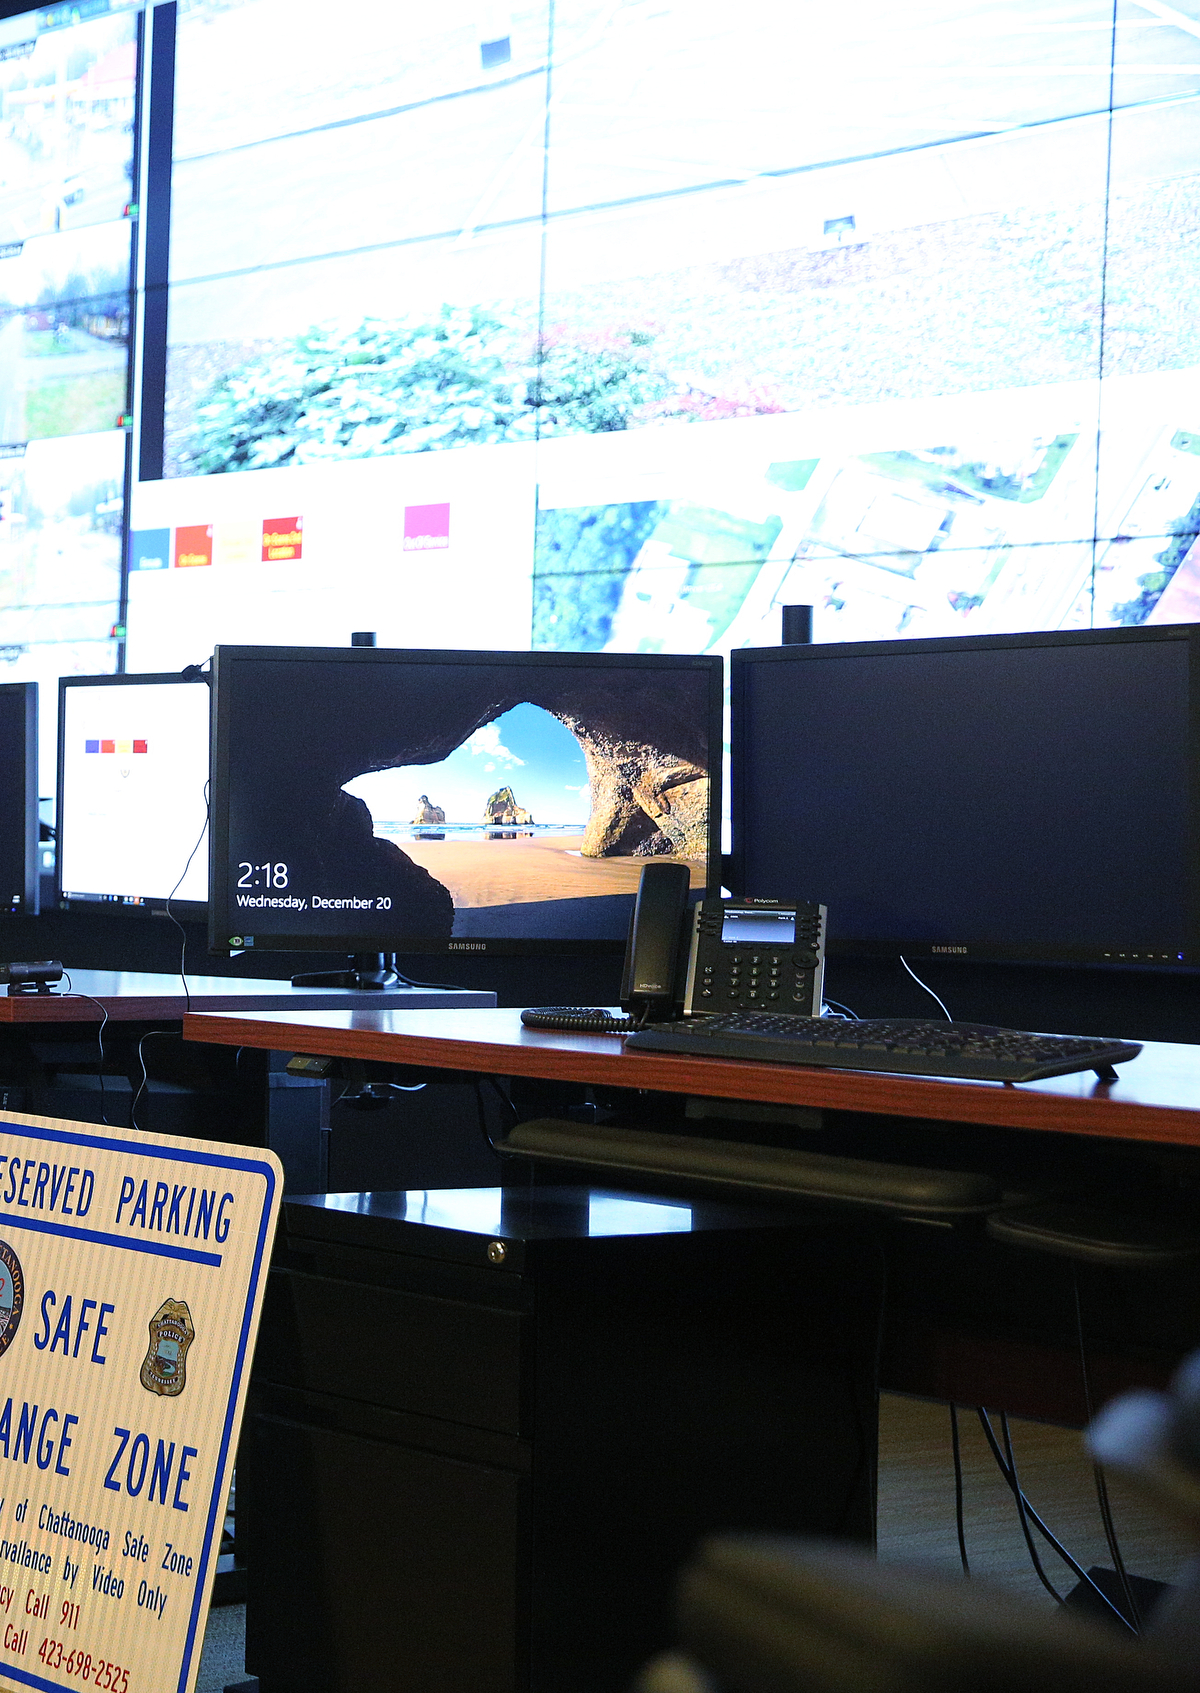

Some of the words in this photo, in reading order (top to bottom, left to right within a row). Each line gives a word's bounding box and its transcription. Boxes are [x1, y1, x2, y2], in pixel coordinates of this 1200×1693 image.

[237, 862, 289, 889] 2:18
[236, 894, 308, 911] Wednesday,
[311, 895, 374, 909] December
[375, 897, 392, 910] 20
[448, 942, 487, 951] SAMSUNG
[931, 945, 968, 954] SAMSUNG
[115, 1176, 235, 1244] PARKING
[34, 1290, 115, 1365] SAFE
[159, 1330, 186, 1343] POLICE
[104, 1427, 198, 1512] ZONE
[15, 1498, 29, 1523] of
[38, 1504, 110, 1556] Chattanooga
[122, 1530, 149, 1563] Safe
[161, 1543, 193, 1577] Zone
[25, 1589, 50, 1620] Call
[60, 1600, 81, 1631] 911
[62, 1555, 79, 1590] by
[92, 1564, 125, 1599] Video
[137, 1580, 168, 1620] Only
[3, 1623, 29, 1655] Call
[38, 1637, 131, 1693] 423-698-2525
